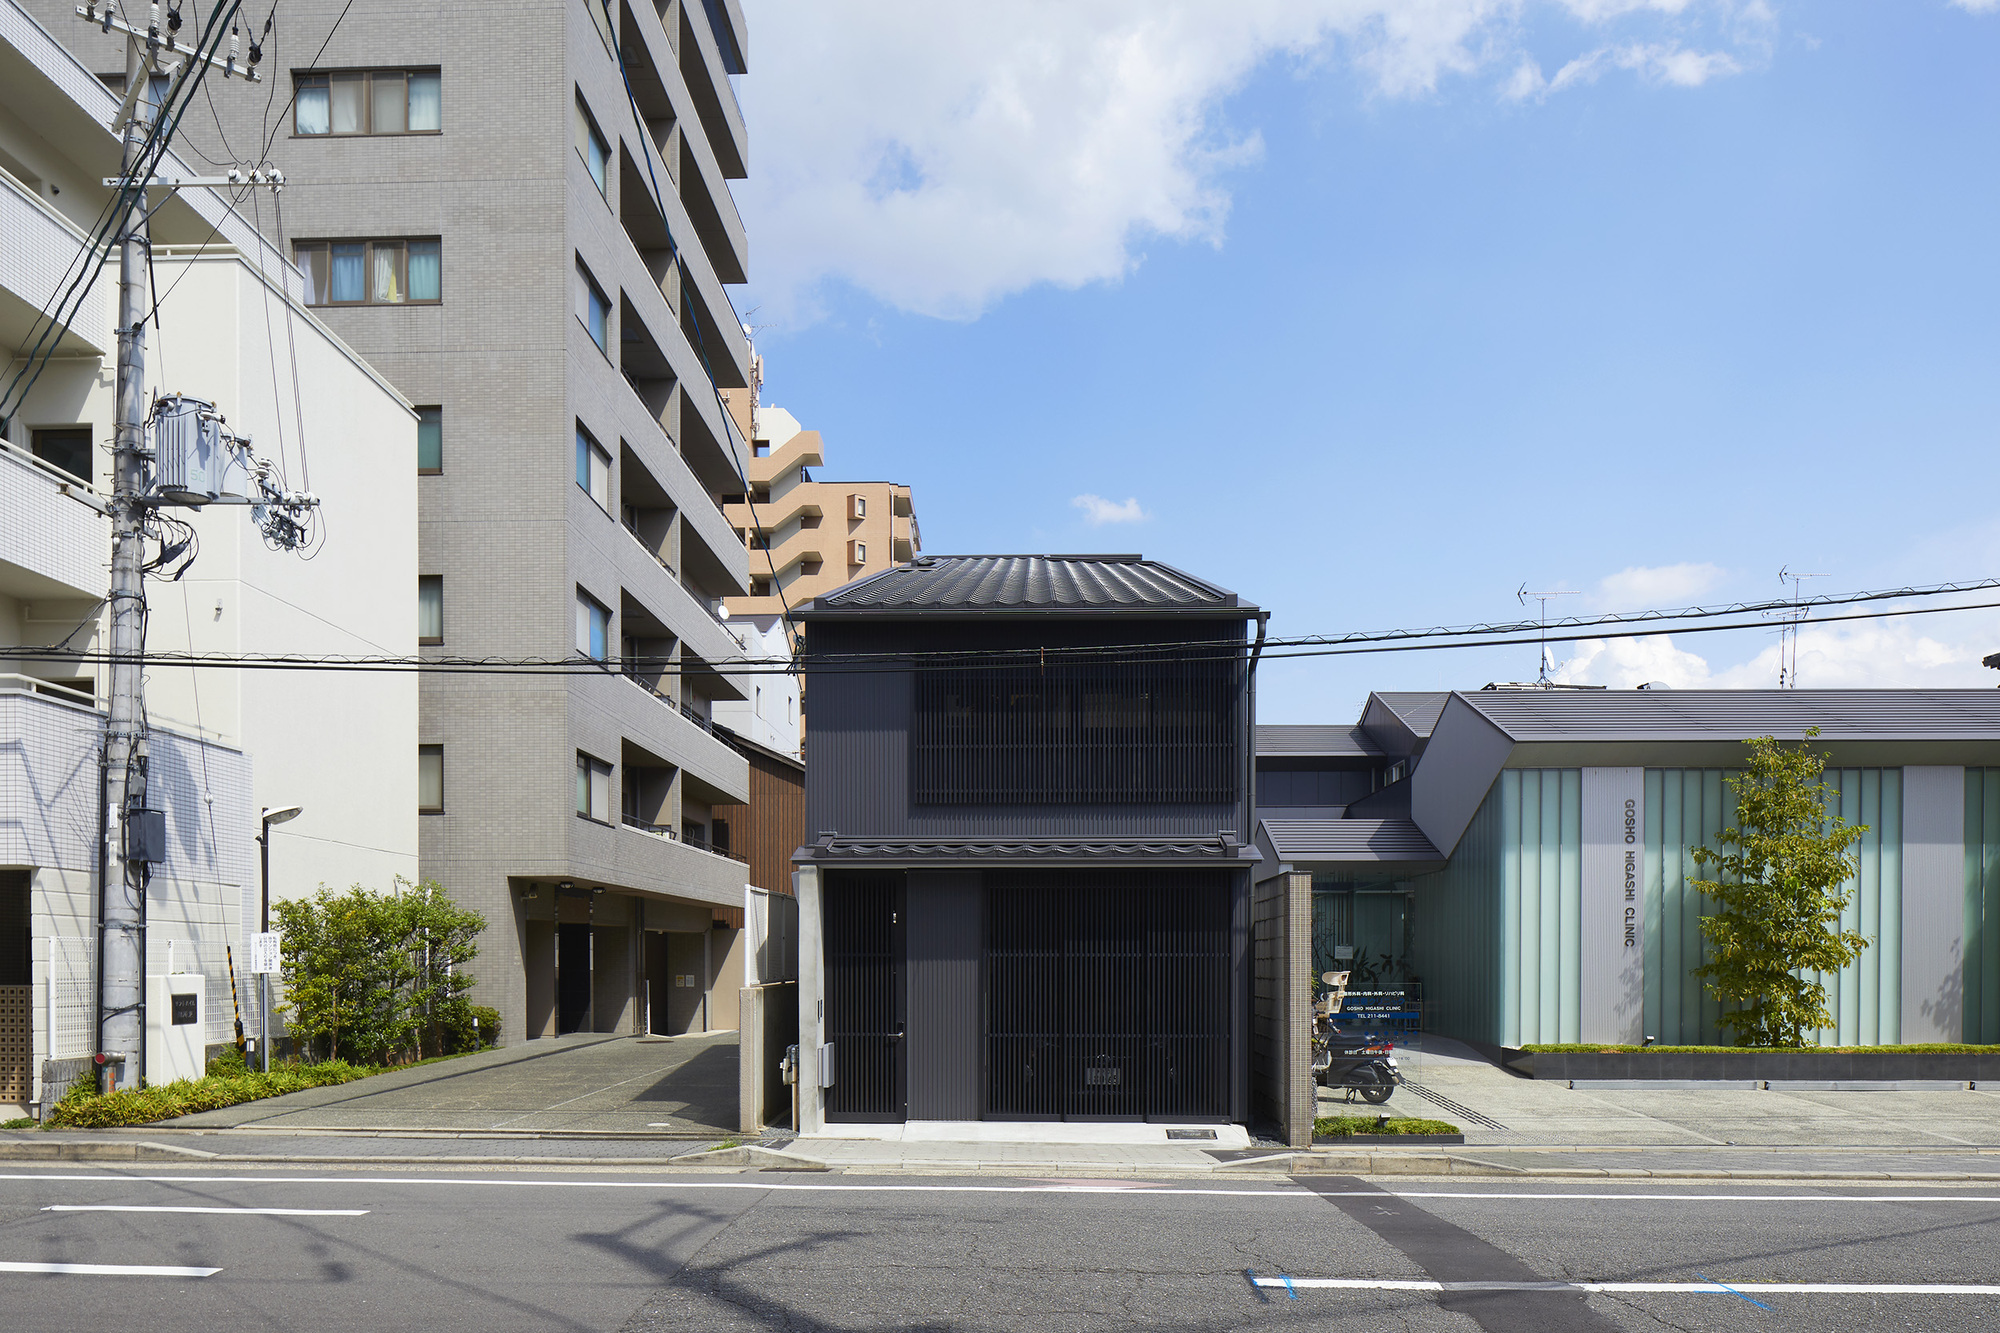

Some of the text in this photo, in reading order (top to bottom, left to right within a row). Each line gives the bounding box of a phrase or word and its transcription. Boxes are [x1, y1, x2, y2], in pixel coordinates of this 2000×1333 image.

[191, 469, 205, 482] 50
[1625, 799, 1635, 947] GOSHO HIGASHI CLINIC
